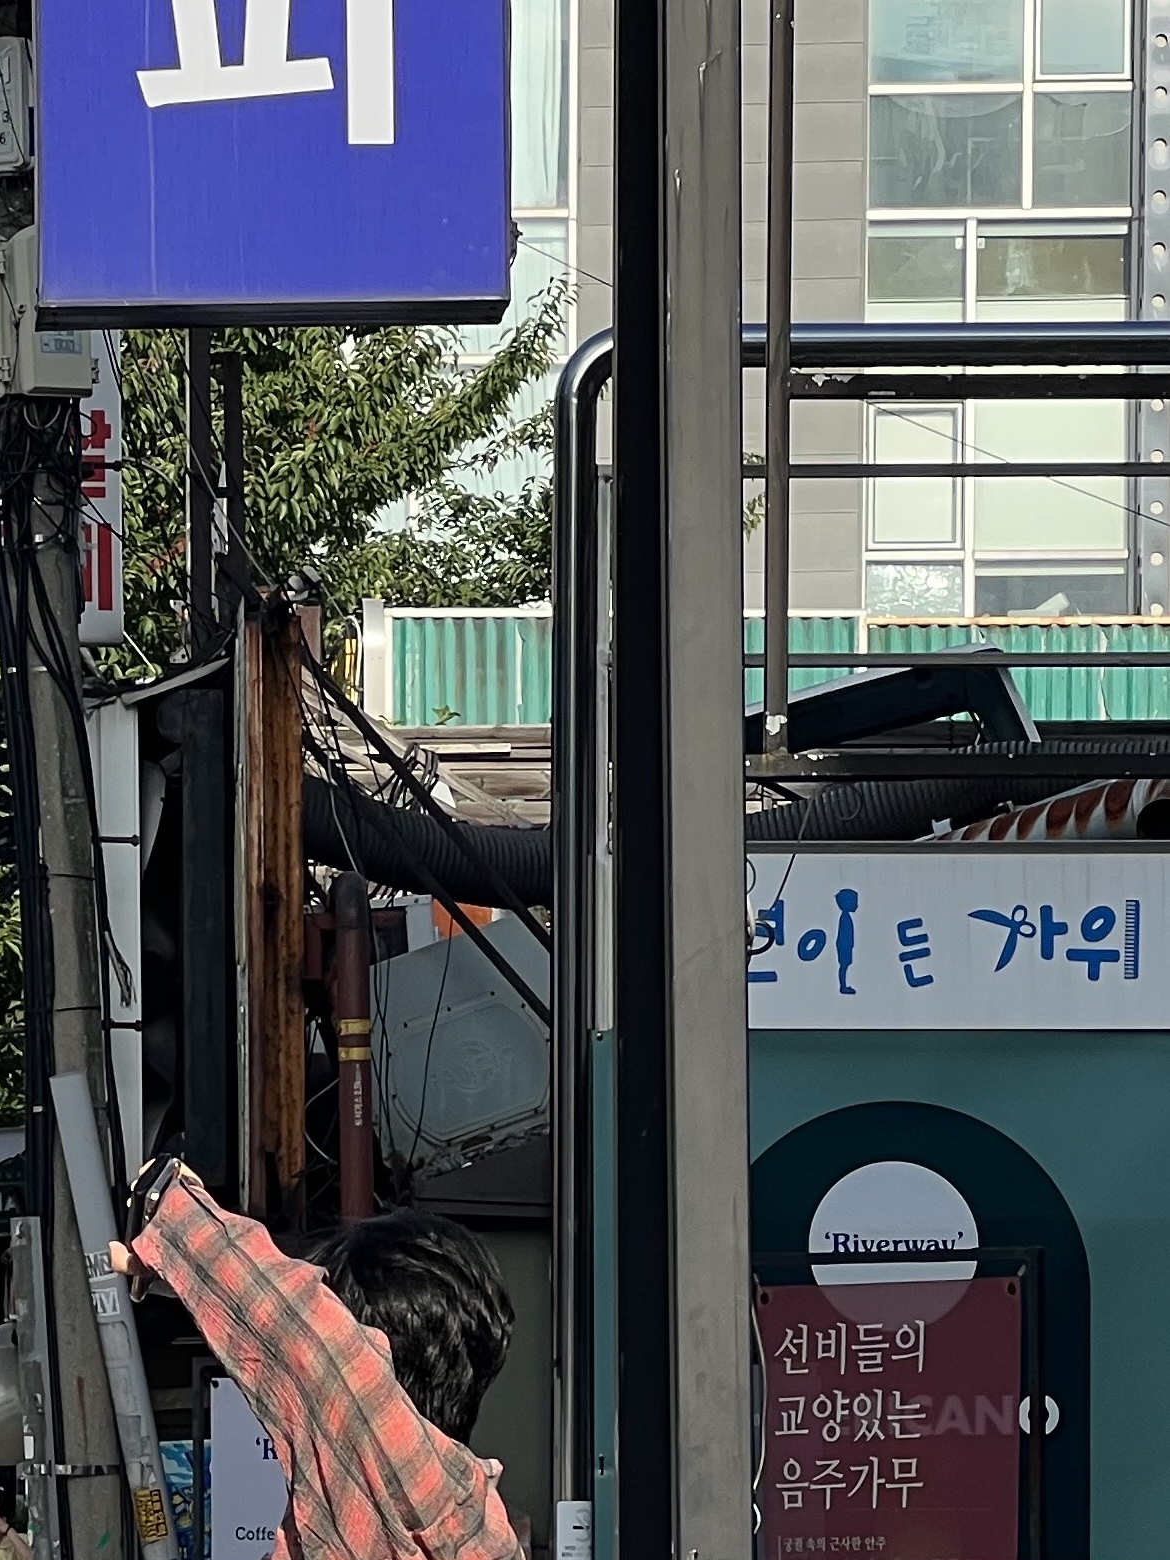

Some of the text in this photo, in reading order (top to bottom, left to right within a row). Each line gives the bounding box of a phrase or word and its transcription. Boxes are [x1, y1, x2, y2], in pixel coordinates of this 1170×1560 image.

[897, 917, 934, 988] 든
[967, 899, 1140, 981] 가위
[774, 1319, 927, 1375] 선비들의
[774, 1388, 927, 1443] 교양있는
[775, 1456, 924, 1510] 음주가무
